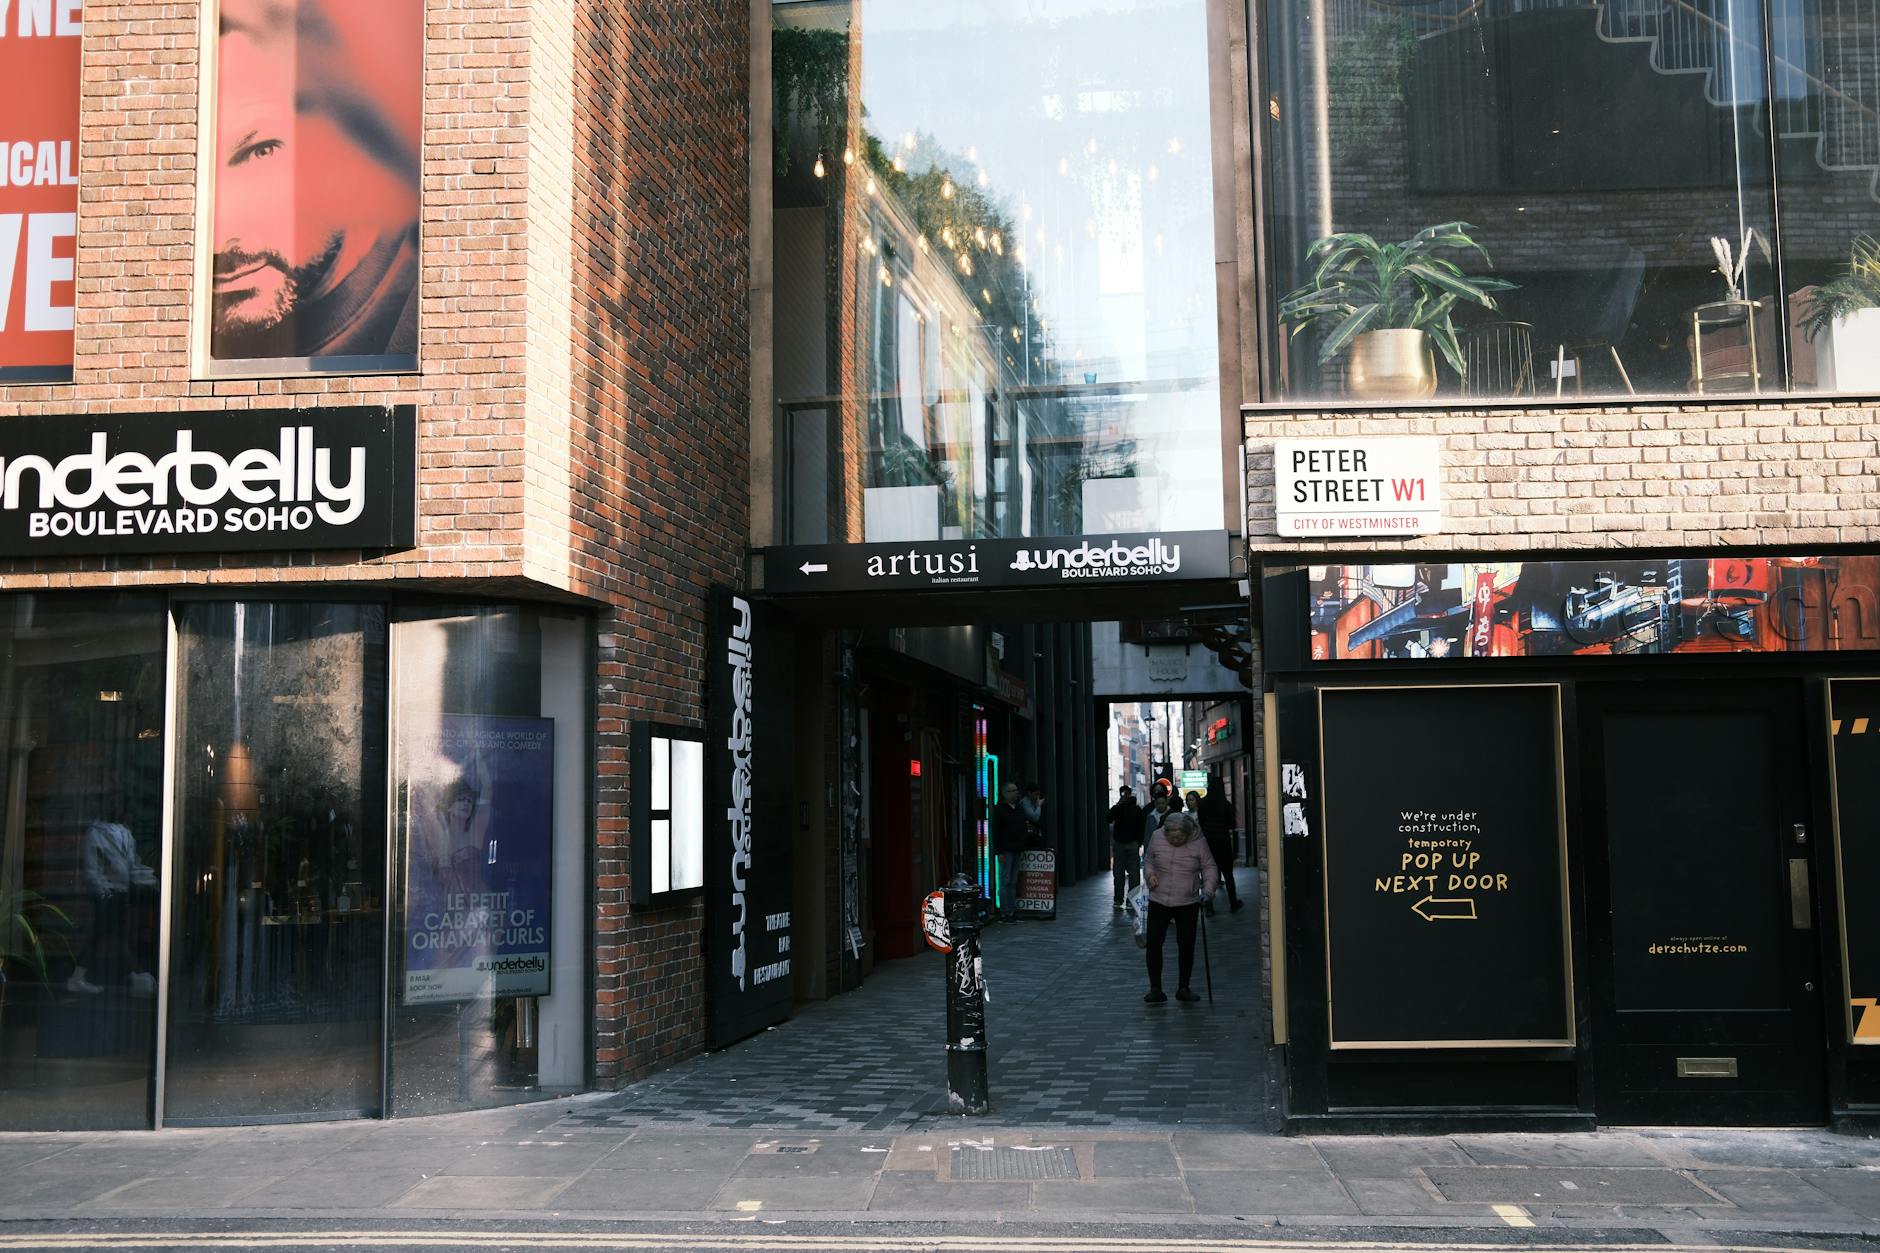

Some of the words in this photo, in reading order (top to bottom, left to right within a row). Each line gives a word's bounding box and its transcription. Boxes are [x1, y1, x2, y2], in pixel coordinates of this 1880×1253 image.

[1293, 449, 1367, 472] PETER
[0, 427, 366, 525] nderbelly
[1294, 479, 1384, 503] STREET
[1392, 478, 1425, 502] W1
[29, 507, 219, 538] BOULEVARD
[223, 505, 314, 532] SOHO
[1294, 519, 1319, 529] CITY
[1322, 518, 1335, 529] OF
[1338, 517, 1419, 529] WESTMINSTER
[867, 545, 980, 576] artusi
[1034, 538, 1181, 573] underbelly
[1061, 566, 1128, 579] BOULEVARD
[1130, 565, 1163, 576] SOHO
[506, 731, 534, 741] WORLD
[507, 741, 542, 750] COMEDY
[728, 596, 752, 936] underbelly
[1401, 811, 1436, 821] We're
[1441, 810, 1477, 821] under
[1398, 822, 1480, 834] construction,
[1408, 838, 1472, 851] temporary
[1402, 853, 1442, 870] POP
[1452, 852, 1480, 870] UP
[1375, 875, 1439, 893] NEXT
[1448, 874, 1508, 892] DOOR
[447, 893, 465, 911] LE
[469, 891, 510, 910] PETIT
[1016, 900, 1050, 910] OPEN
[424, 911, 507, 931] CABARET
[510, 909, 536, 927] OF
[412, 930, 488, 950] ORIANA
[492, 926, 545, 946] CURLS
[1648, 942, 1748, 954] derschutze.com
[486, 956, 545, 972] underbelly
